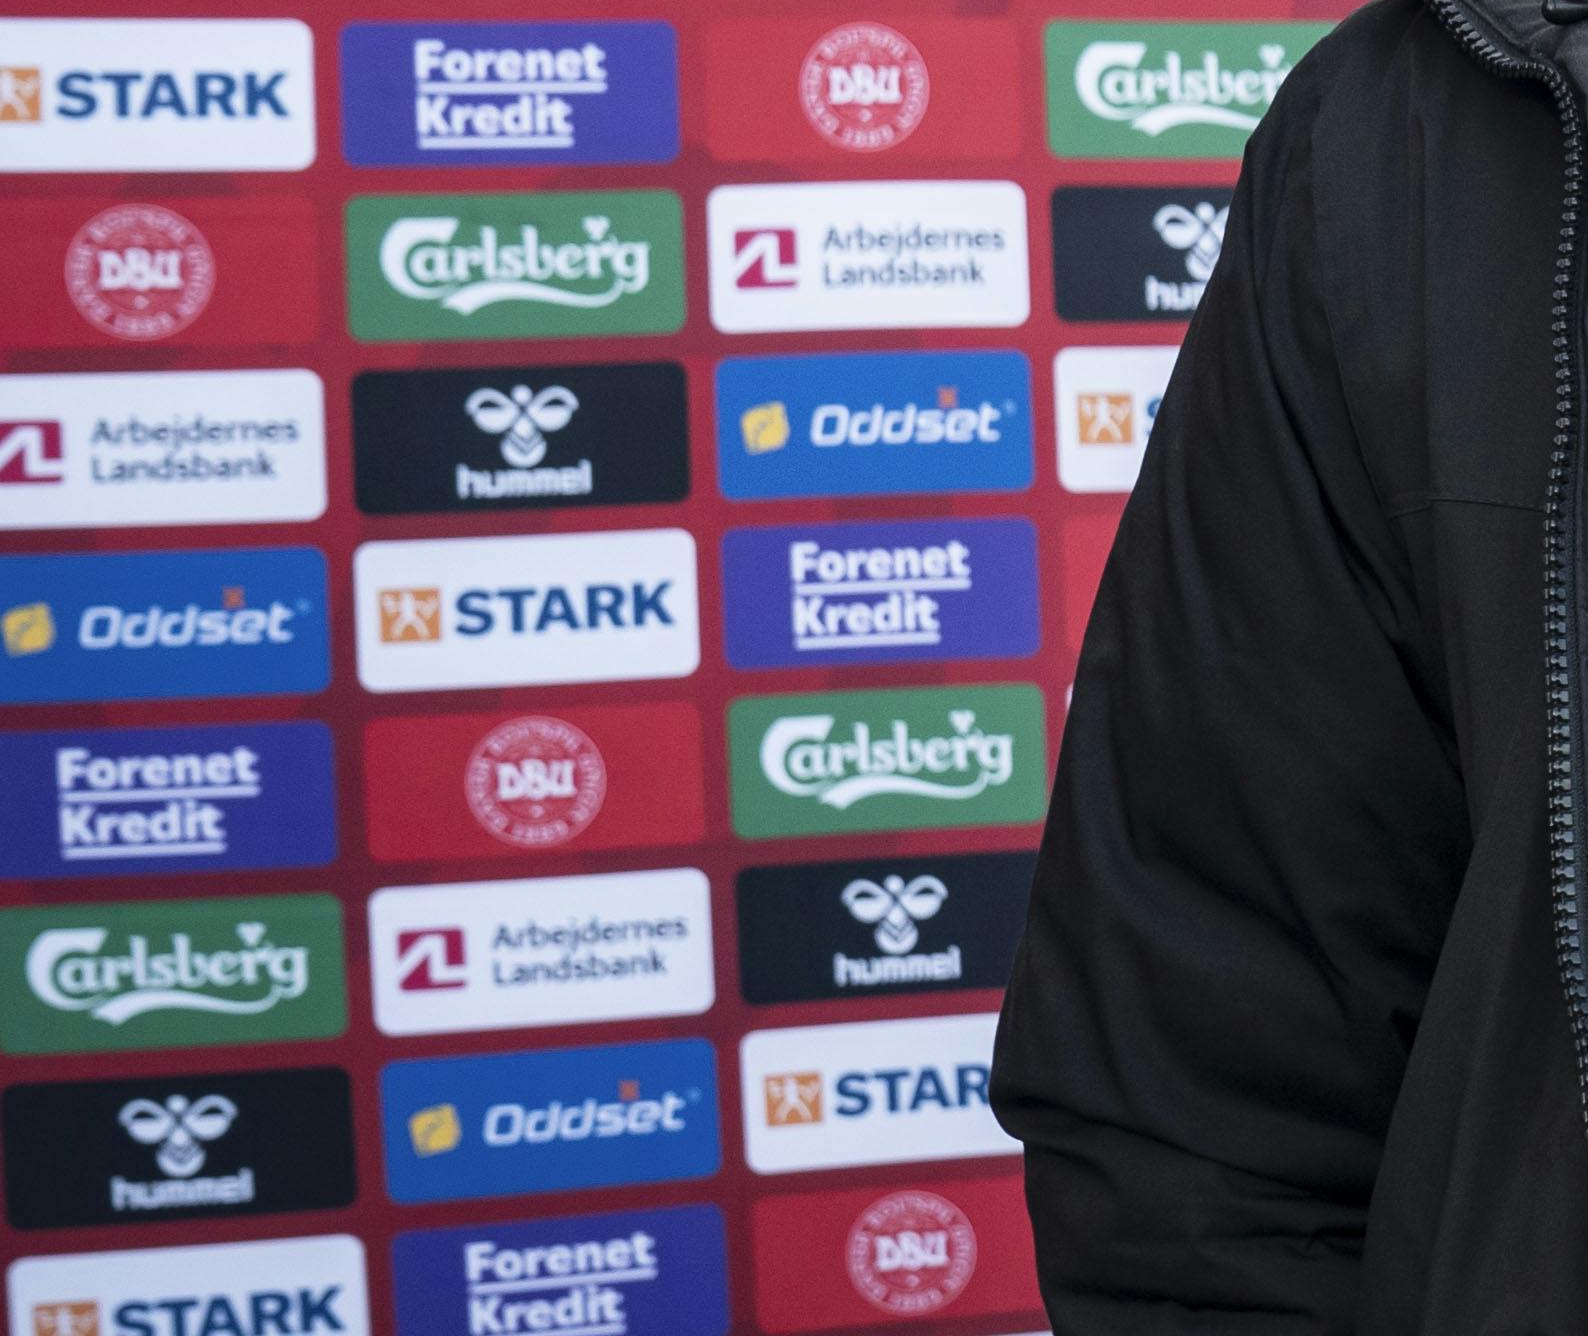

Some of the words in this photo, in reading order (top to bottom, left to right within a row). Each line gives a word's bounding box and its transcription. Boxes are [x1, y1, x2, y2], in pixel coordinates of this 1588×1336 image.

[415, 39, 606, 81] Forenet
[56, 71, 289, 119] STARK
[828, 64, 902, 104] DBU
[1076, 40, 1291, 136] Carlsber
[419, 95, 573, 137] Kredit
[822, 223, 1004, 261] Arbejdernes
[98, 247, 183, 291] DBU
[380, 217, 650, 315] Carlsberg
[822, 254, 984, 289] Landsbank
[91, 414, 299, 455] Arbejdernes
[809, 401, 1001, 449] Oddset
[91, 449, 273, 486] Landsbank
[457, 462, 592, 498] hummel
[790, 544, 969, 585] Forenet
[79, 600, 293, 650] Oddset
[455, 582, 673, 633] STARK
[794, 595, 938, 636] Kredit
[56, 746, 258, 788] Forenet
[497, 759, 576, 800] DBU
[759, 710, 1012, 808] Carlsberg
[61, 804, 225, 844] Kredit
[492, 913, 687, 954] Arbejdernes
[25, 922, 309, 1024] Carlsberg
[492, 947, 667, 985] Landsbank
[834, 945, 961, 987] hummel
[834, 1063, 989, 1116] STAR
[483, 1093, 687, 1148] Oddset
[111, 1170, 253, 1210] hummel
[466, 1231, 654, 1280] Forenet
[112, 1284, 344, 1336] STARK
[469, 1288, 623, 1334] Kredit
